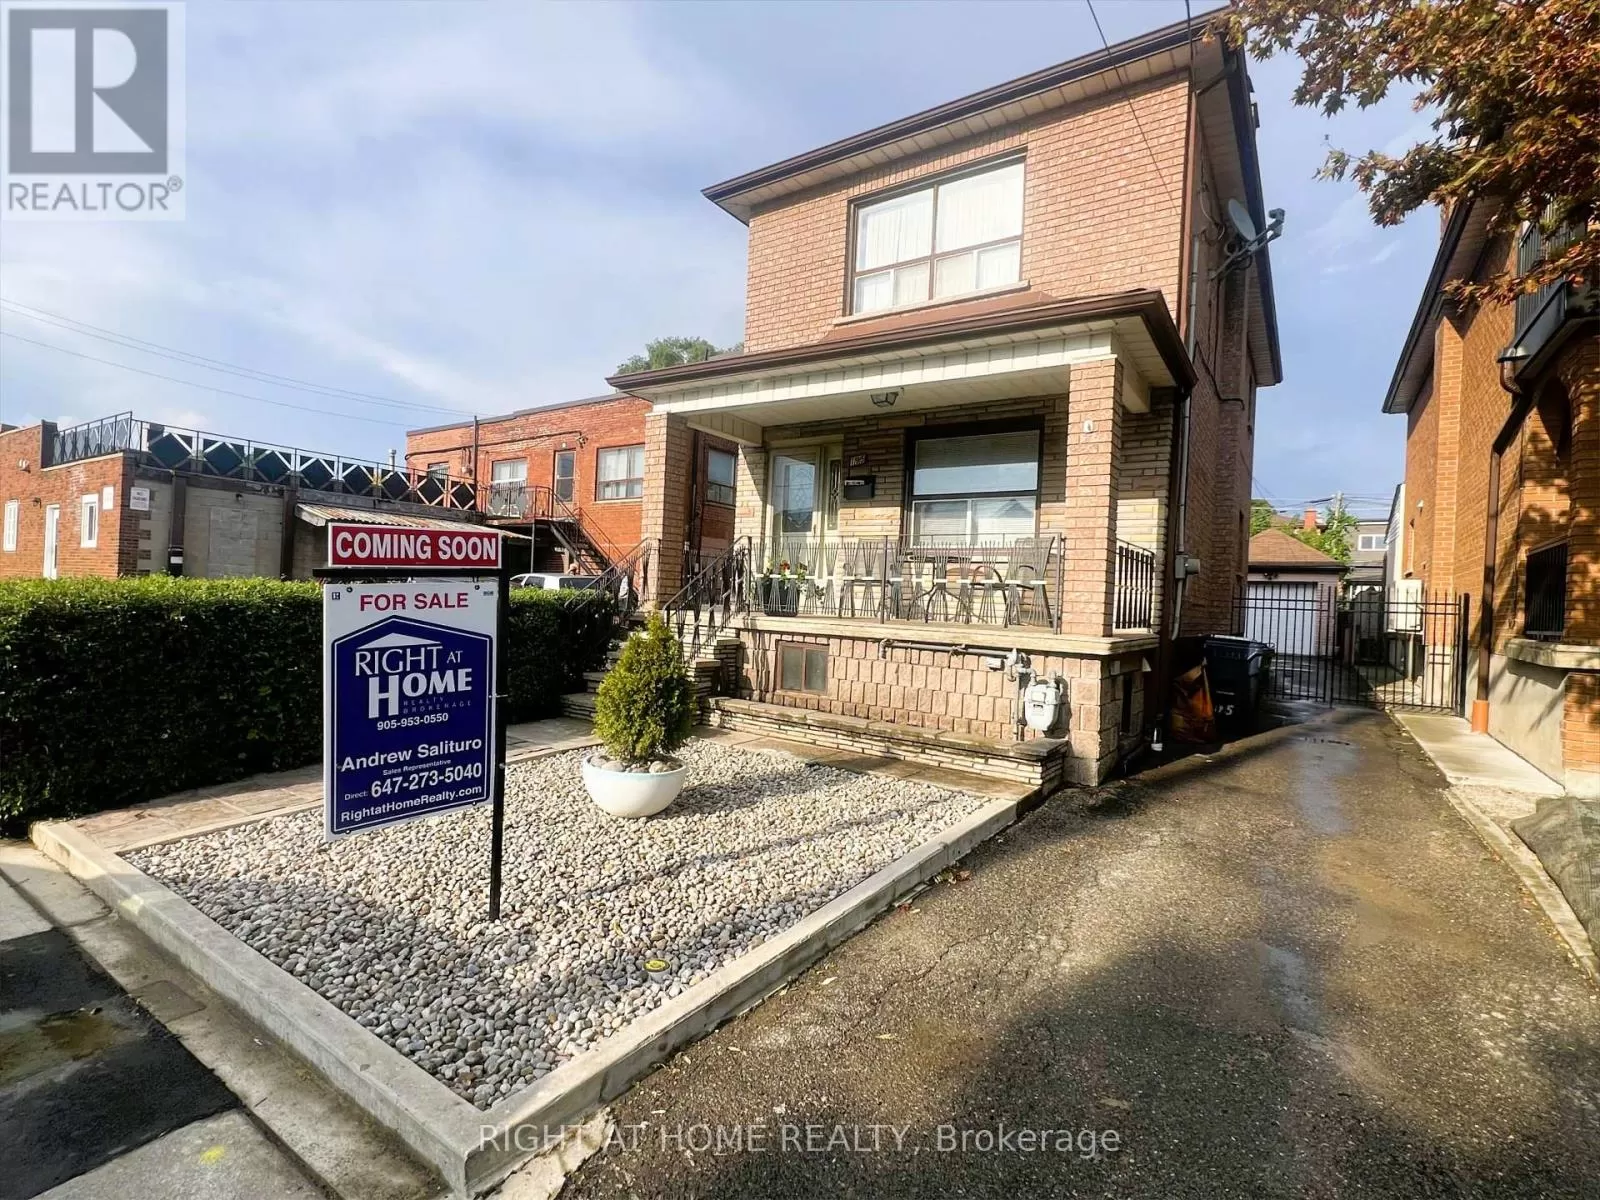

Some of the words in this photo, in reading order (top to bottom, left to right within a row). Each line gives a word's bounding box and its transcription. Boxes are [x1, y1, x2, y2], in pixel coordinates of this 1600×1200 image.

[335, 531, 431, 560] COMING
[438, 535, 496, 561] SOON
[360, 594, 406, 611] FOR
[414, 592, 469, 609] SALE
[355, 646, 443, 676] RIGHT
[446, 651, 463, 663] AT
[368, 668, 472, 718] HOME
[377, 712, 449, 731] 905-953-0550
[341, 750, 412, 772] Andrew
[417, 738, 482, 759] Salituro
[383, 768, 401, 776] Sales
[403, 759, 451, 772] Representative
[344, 790, 368, 801] Direct:
[371, 762, 482, 798] 647-273-5040
[341, 785, 482, 822] RightatHomeRealty.com
